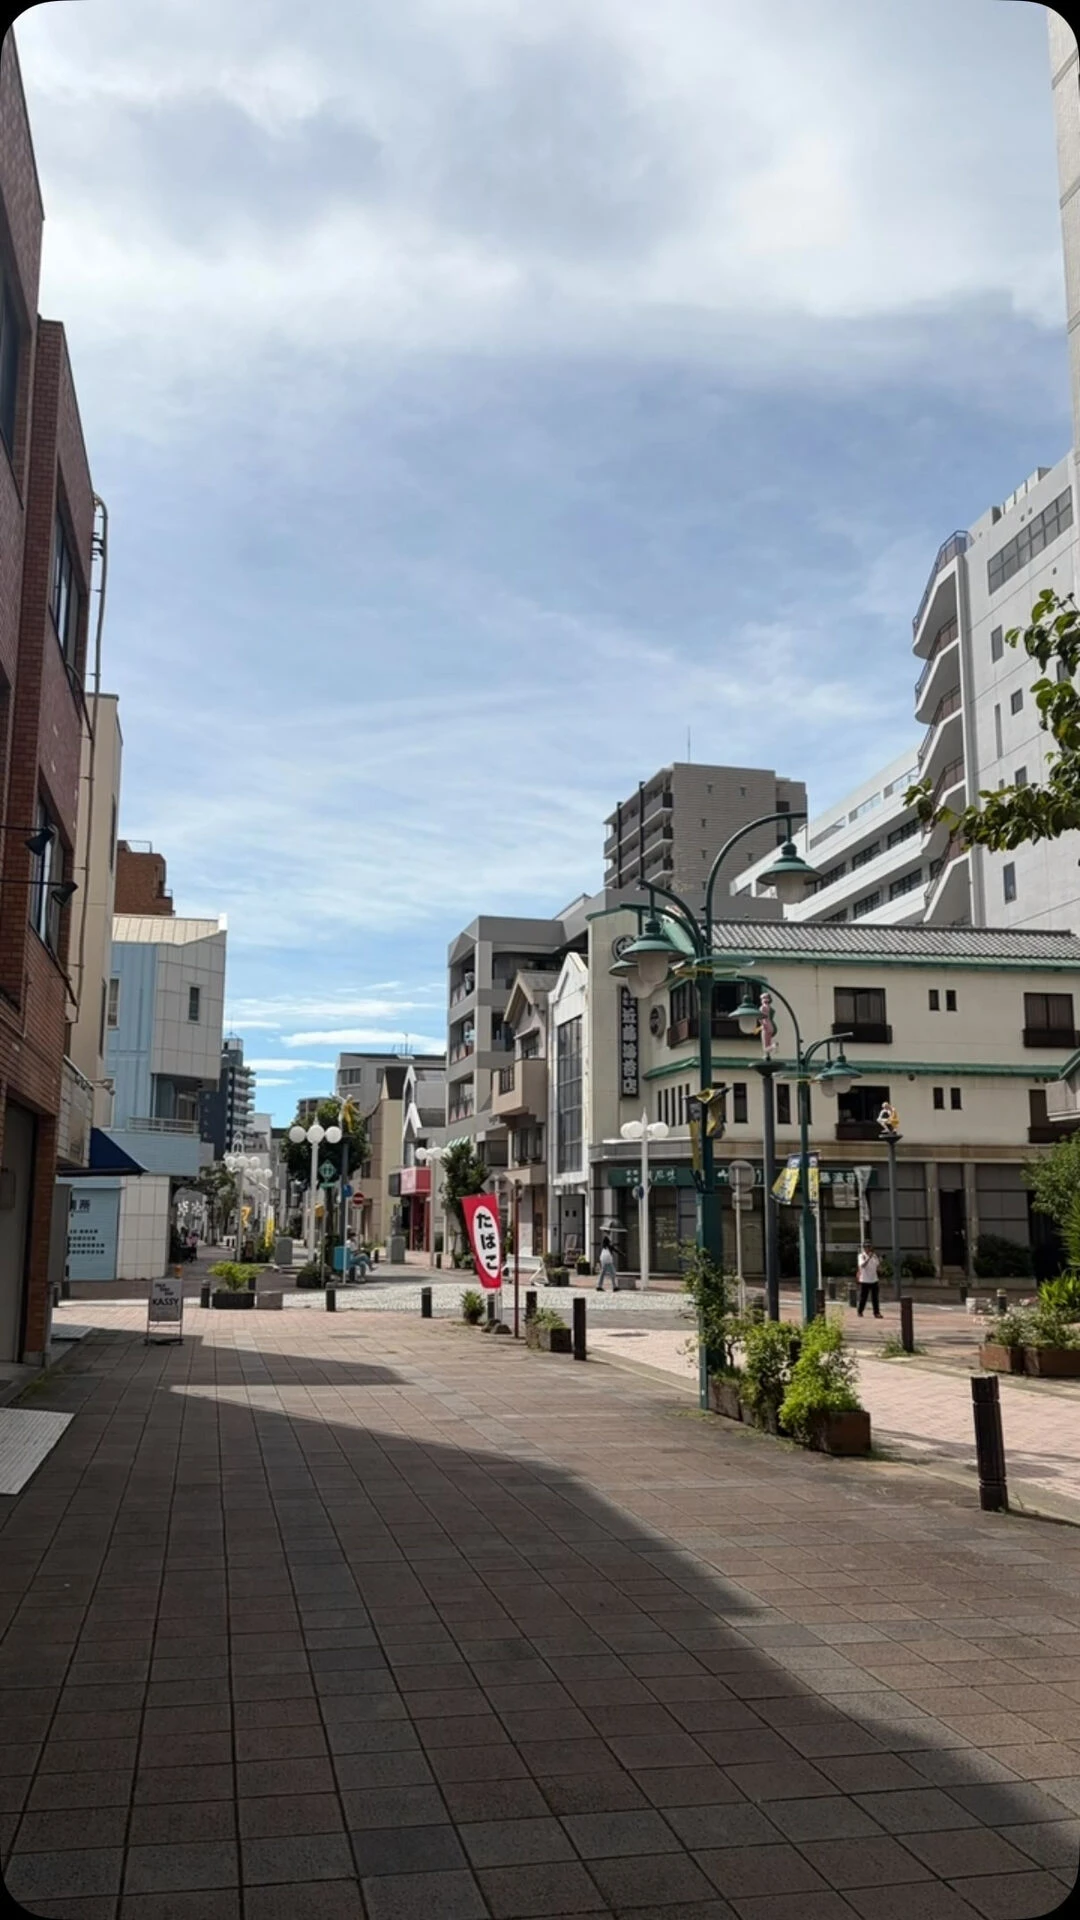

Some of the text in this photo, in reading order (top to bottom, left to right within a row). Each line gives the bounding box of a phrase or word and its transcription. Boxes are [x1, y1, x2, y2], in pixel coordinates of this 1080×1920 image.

[476, 1212, 498, 1270] たばこ
[152, 1297, 179, 1306] KASSY
